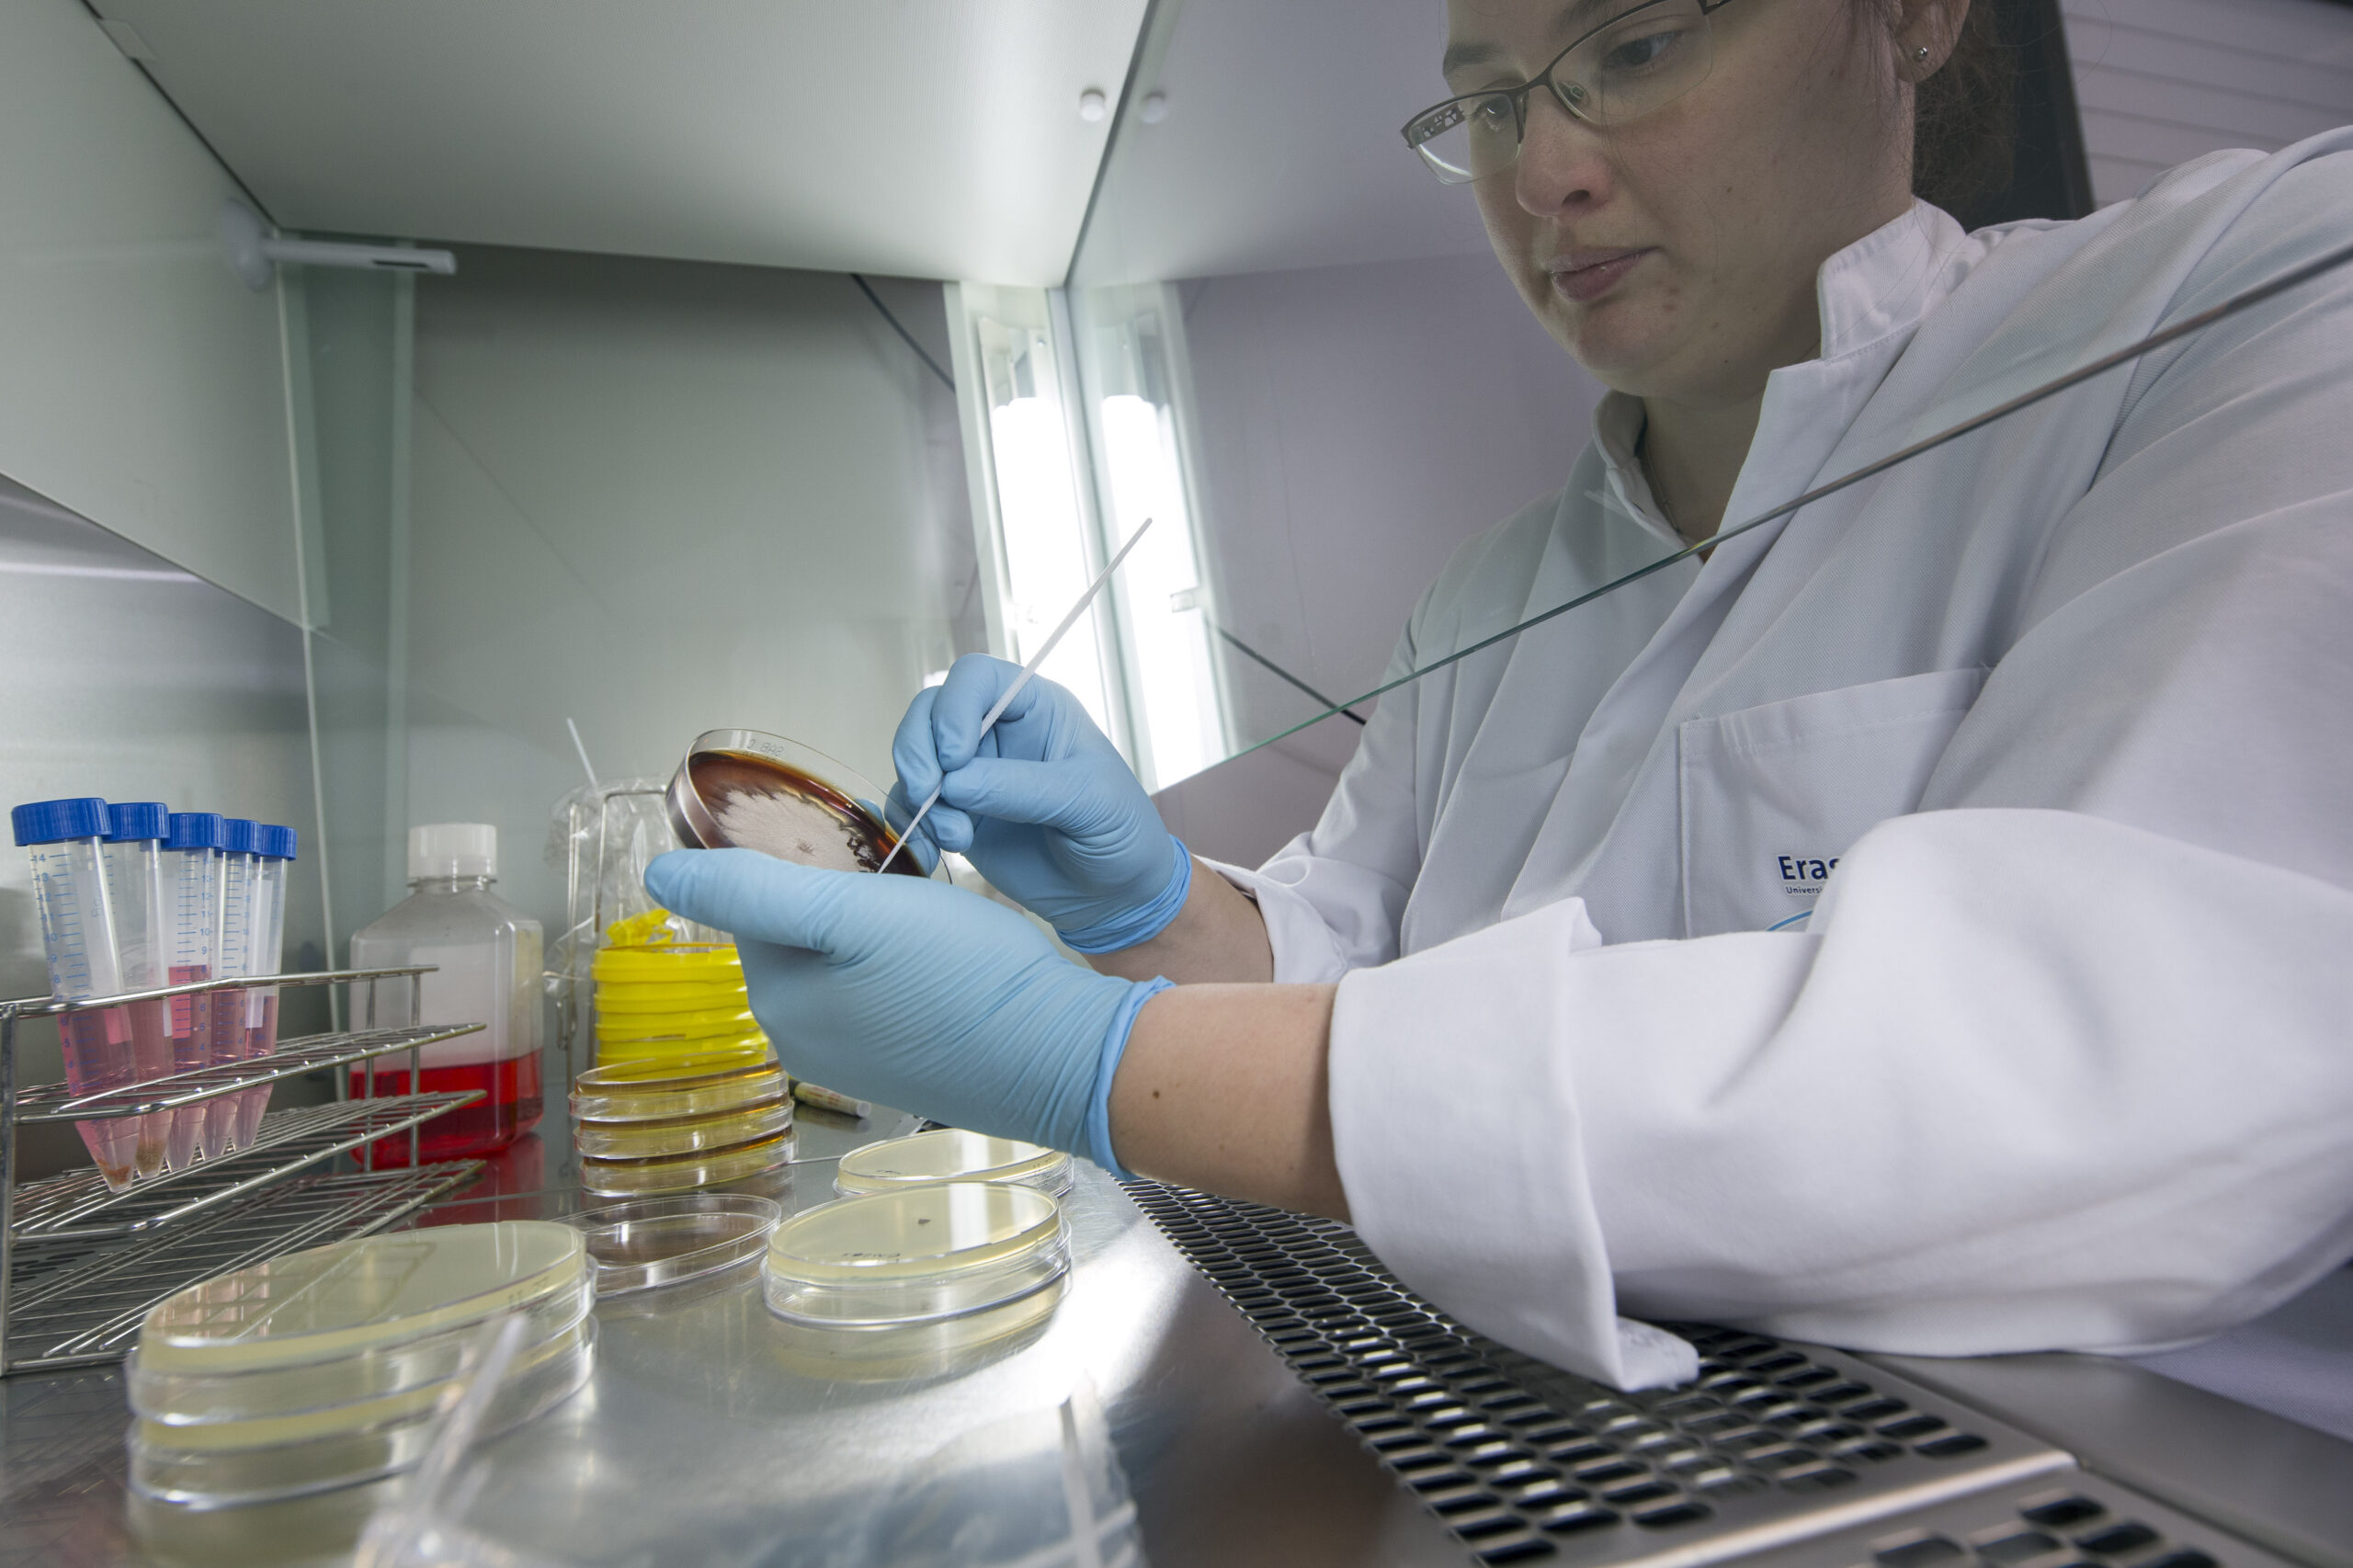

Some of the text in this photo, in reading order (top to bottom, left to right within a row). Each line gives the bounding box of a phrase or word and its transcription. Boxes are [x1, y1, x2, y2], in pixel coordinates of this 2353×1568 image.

[201, 946, 207, 954] 9
[53, 974, 61, 983] 8
[199, 1003, 206, 1012] 6
[199, 1022, 205, 1031] 5
